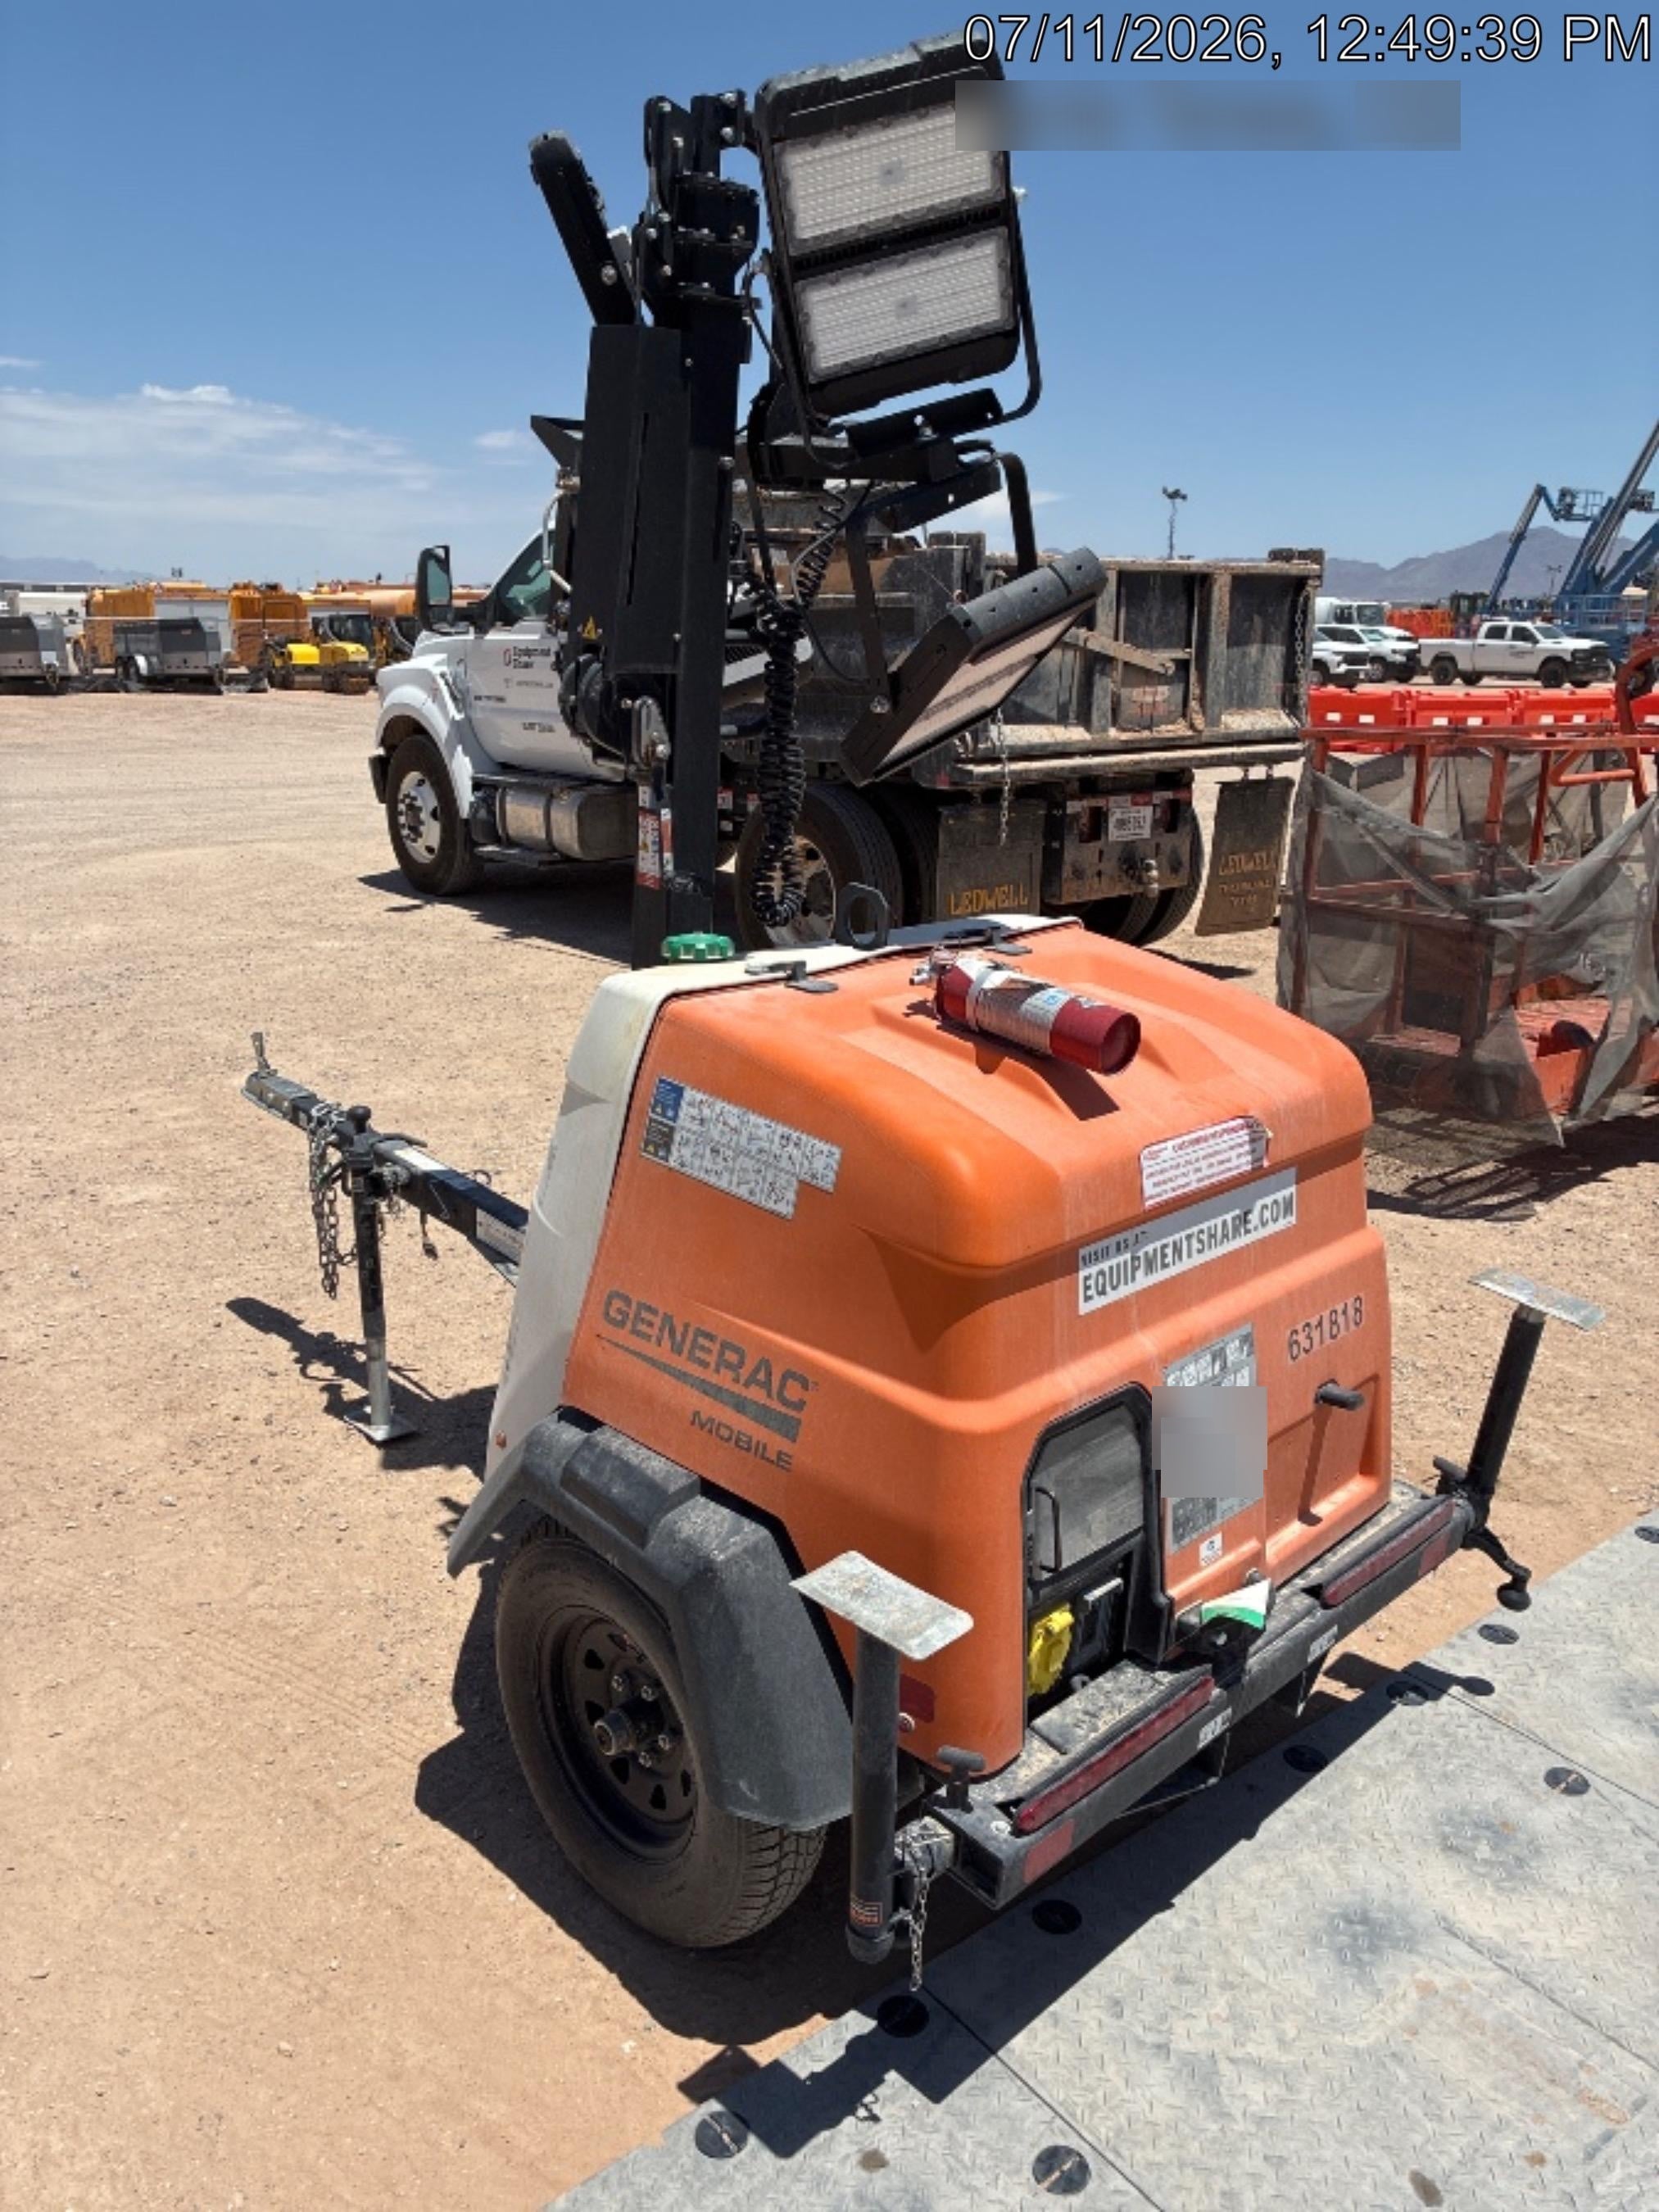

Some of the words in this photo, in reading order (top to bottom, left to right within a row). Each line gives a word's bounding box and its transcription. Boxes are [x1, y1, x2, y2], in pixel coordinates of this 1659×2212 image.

[950, 884, 1028, 915] LEDWELL
[1082, 1190, 1294, 1303] EQUIPMENTSHARE.COM
[605, 1290, 809, 1412] GENERAC
[1287, 1295, 1364, 1363] 631818
[691, 1412, 793, 1471] MOBILE
